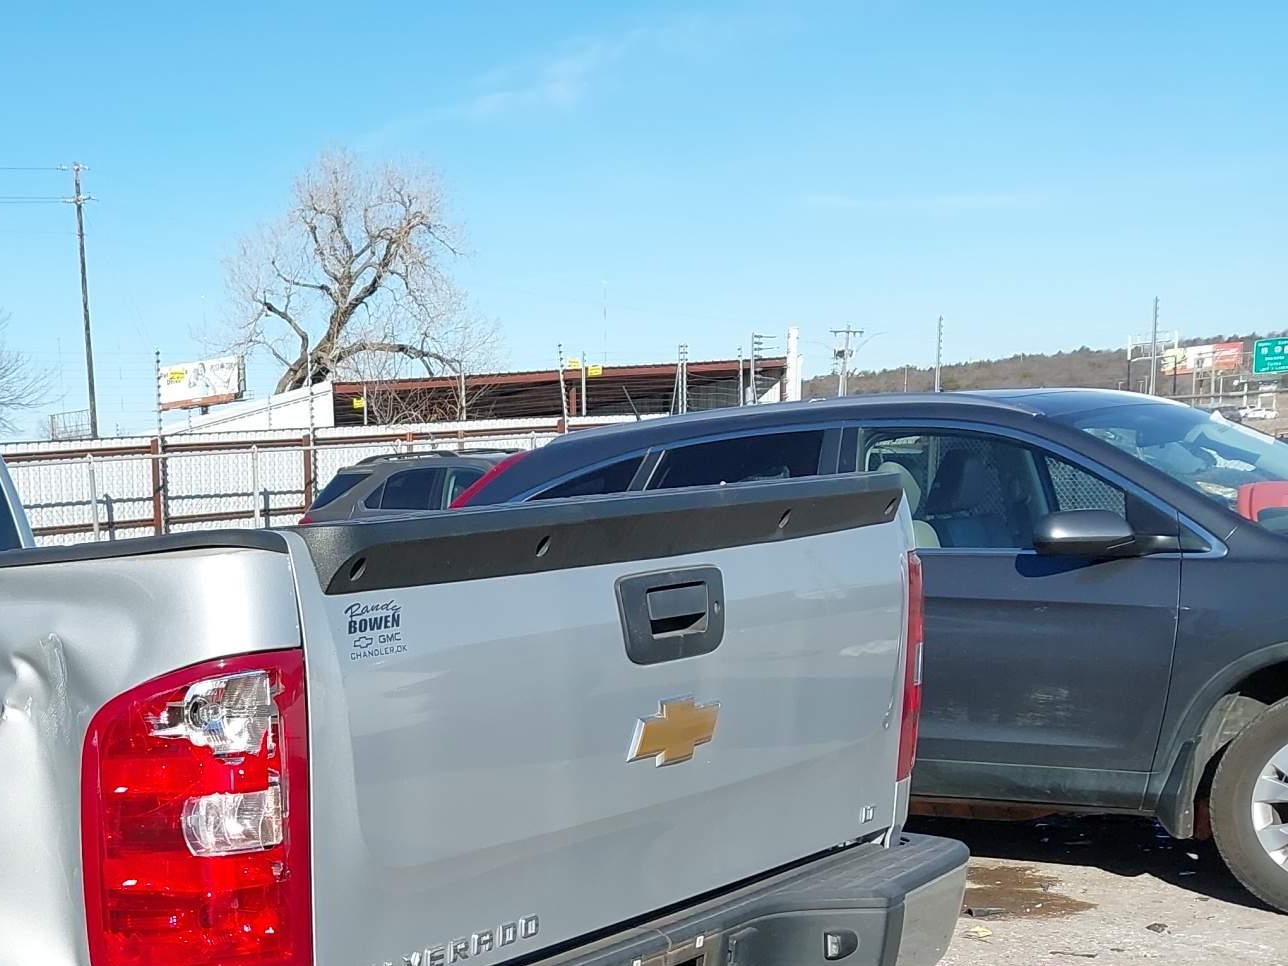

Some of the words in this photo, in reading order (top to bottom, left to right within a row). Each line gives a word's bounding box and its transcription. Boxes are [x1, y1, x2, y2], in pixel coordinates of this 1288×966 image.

[344, 599, 402, 619] Randy
[348, 613, 400, 634] BOWEN
[378, 632, 402, 643] GMC
